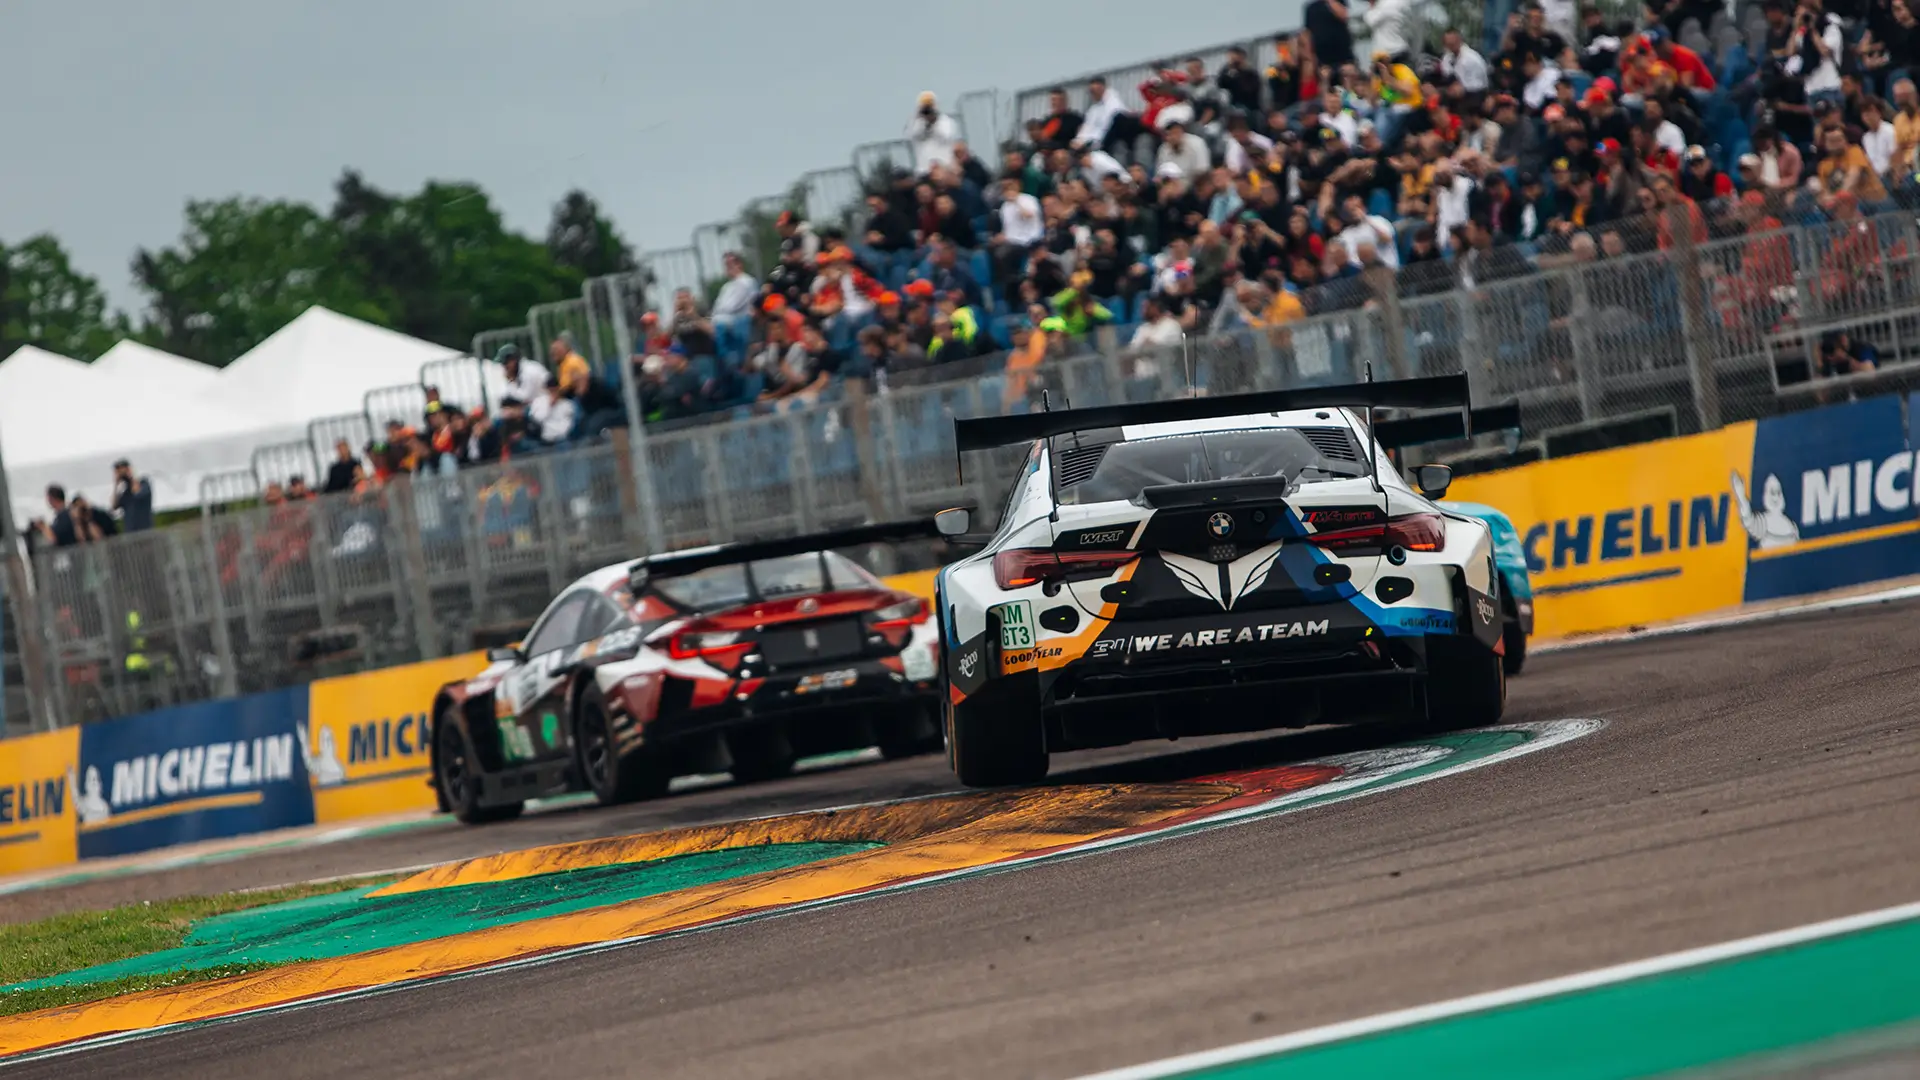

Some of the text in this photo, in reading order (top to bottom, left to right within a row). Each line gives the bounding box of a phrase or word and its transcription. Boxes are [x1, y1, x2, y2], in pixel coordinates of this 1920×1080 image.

[1080, 530, 1124, 545] WRT
[1522, 493, 1731, 573] CHELIN
[1002, 626, 1030, 646] GT3
[1135, 634, 1173, 652] WE
[1177, 628, 1232, 648] ARE
[1235, 627, 1254, 643] A
[1257, 619, 1329, 641] TEAM
[1005, 647, 1062, 665] GOODYEAR
[111, 733, 294, 806] MICHELIN
[0, 775, 65, 823] ELIN
